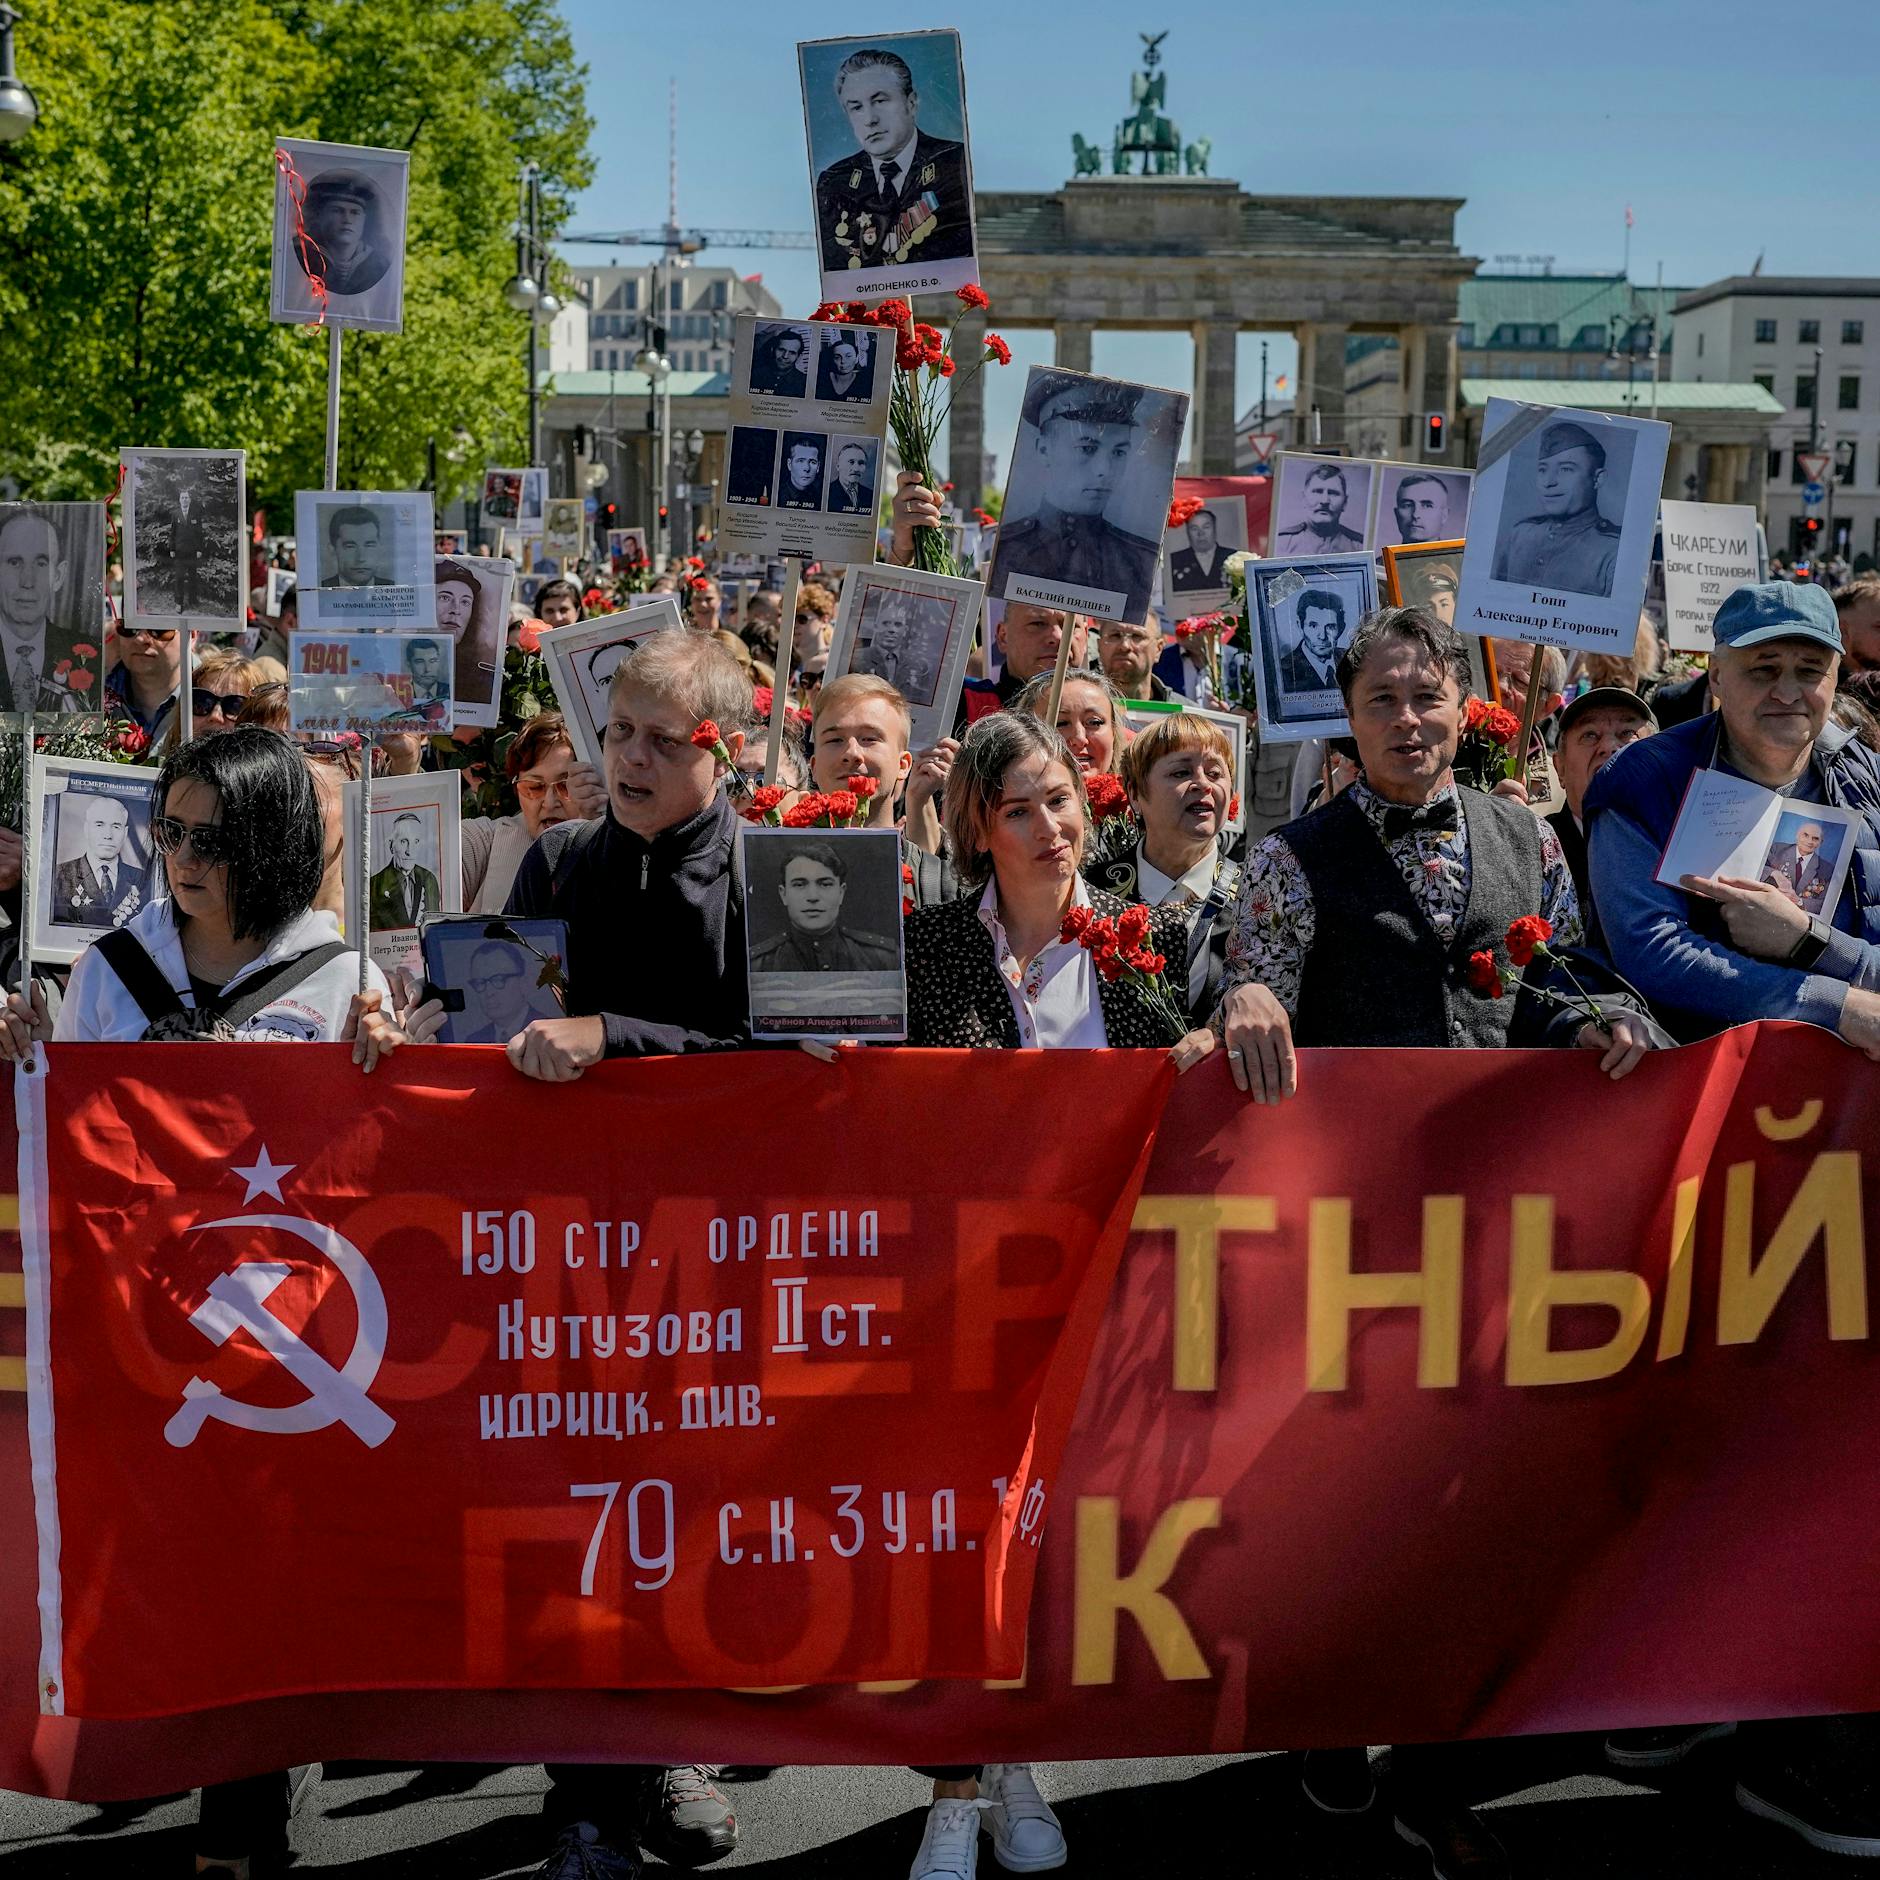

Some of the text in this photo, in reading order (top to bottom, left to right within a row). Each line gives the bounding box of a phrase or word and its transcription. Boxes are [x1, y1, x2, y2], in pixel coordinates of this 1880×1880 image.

[856, 278, 941, 293] ФИЛОНЕНКО В.Ф.
[1670, 533, 1748, 556] ЧКАРЕУЛИ
[1700, 582, 1720, 593] 1922
[1016, 586, 1111, 613] ВАСИЛИЙ ПЯДШЕВ
[1531, 592, 1567, 608] Гопп
[1473, 606, 1619, 637] Александр Егорович
[1538, 634, 1554, 643] 1945
[1555, 638, 1567, 646] год
[391, 934, 418, 943] Иванов
[807, 1016, 848, 1026] Алексей
[850, 1016, 899, 1026] Иванович
[462, 1208, 536, 1276] 150
[708, 1209, 879, 1264] ОРДЕНА
[679, 1383, 776, 1431] ДИВ.
[569, 1478, 675, 1597] 79
